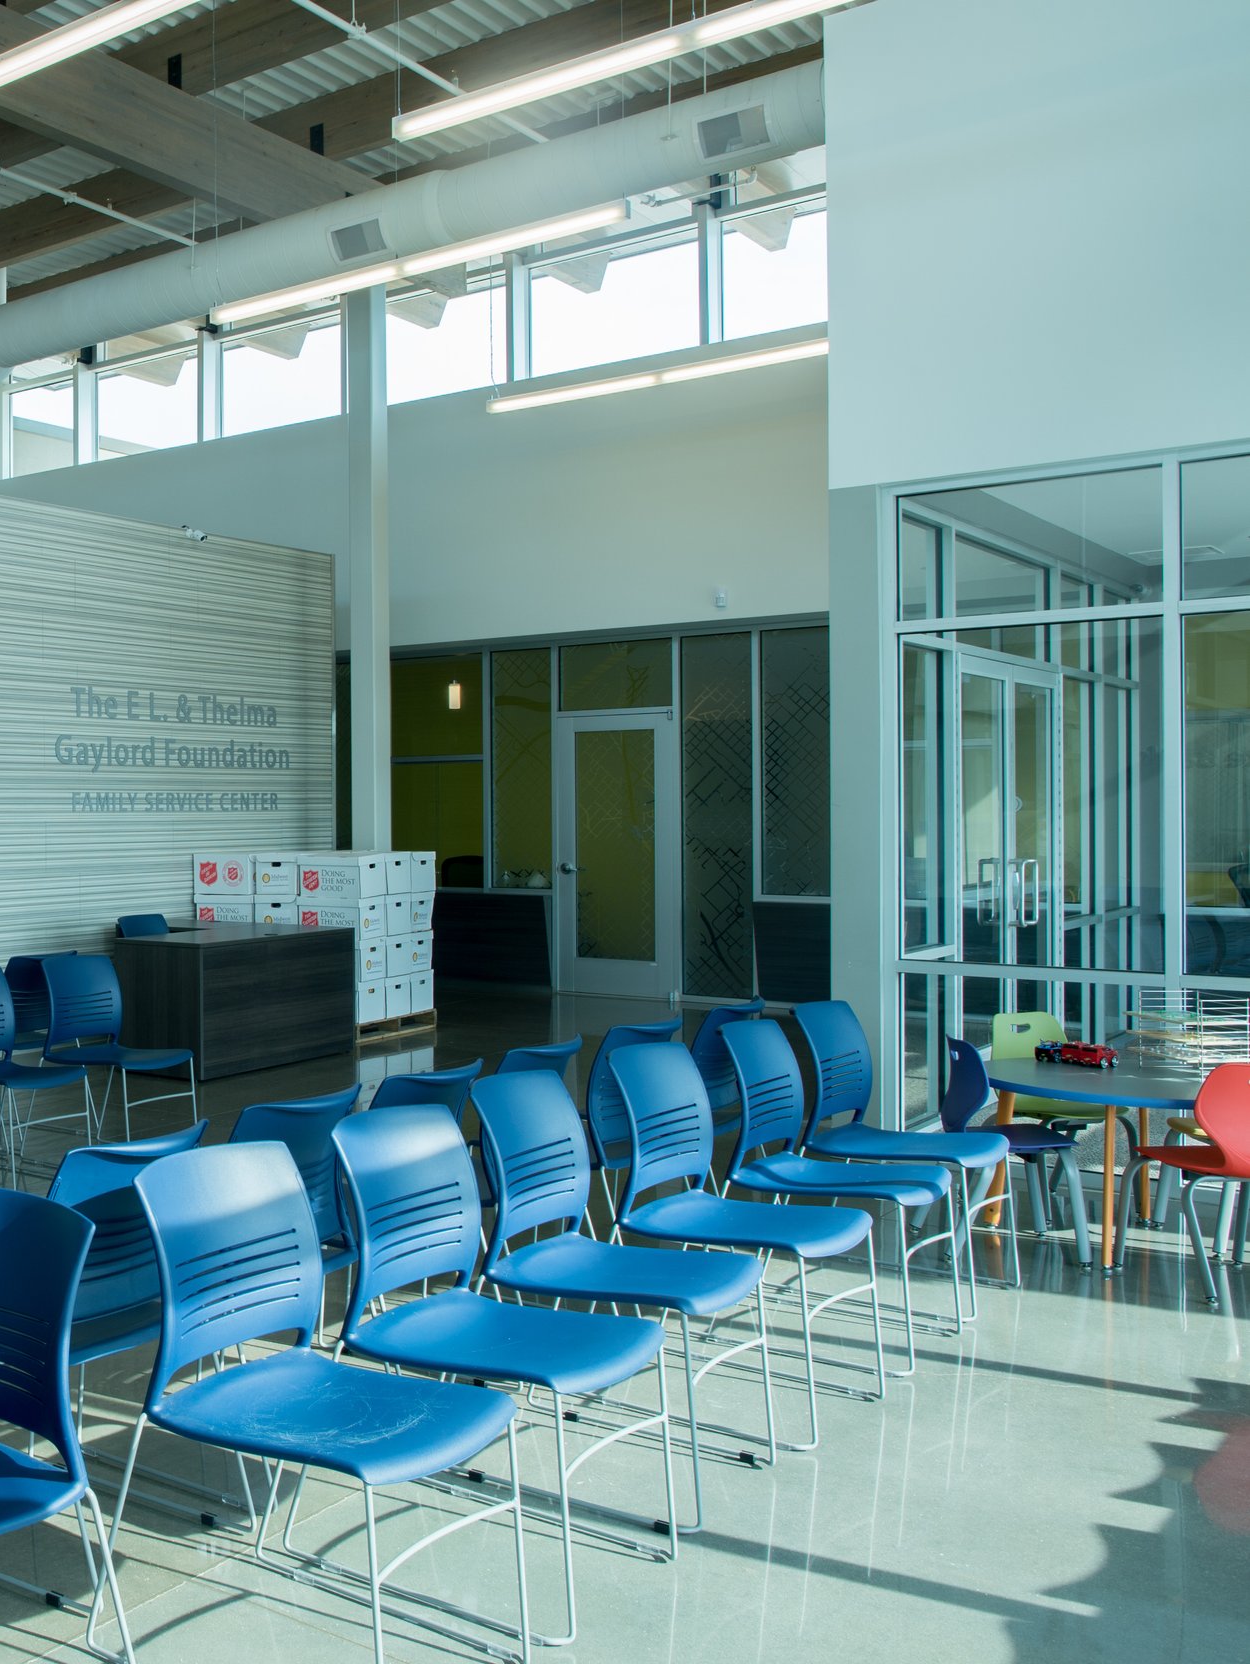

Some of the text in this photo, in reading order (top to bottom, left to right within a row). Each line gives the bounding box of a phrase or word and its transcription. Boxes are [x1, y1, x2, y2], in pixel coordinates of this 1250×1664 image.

[70, 686, 118, 719] The
[176, 694, 192, 722] &
[198, 695, 277, 726] Thelma
[54, 734, 290, 773] Gaylord Foundation
[71, 792, 278, 812] FAMILY SERVICE CENTER
[336, 878, 356, 886] MOST
